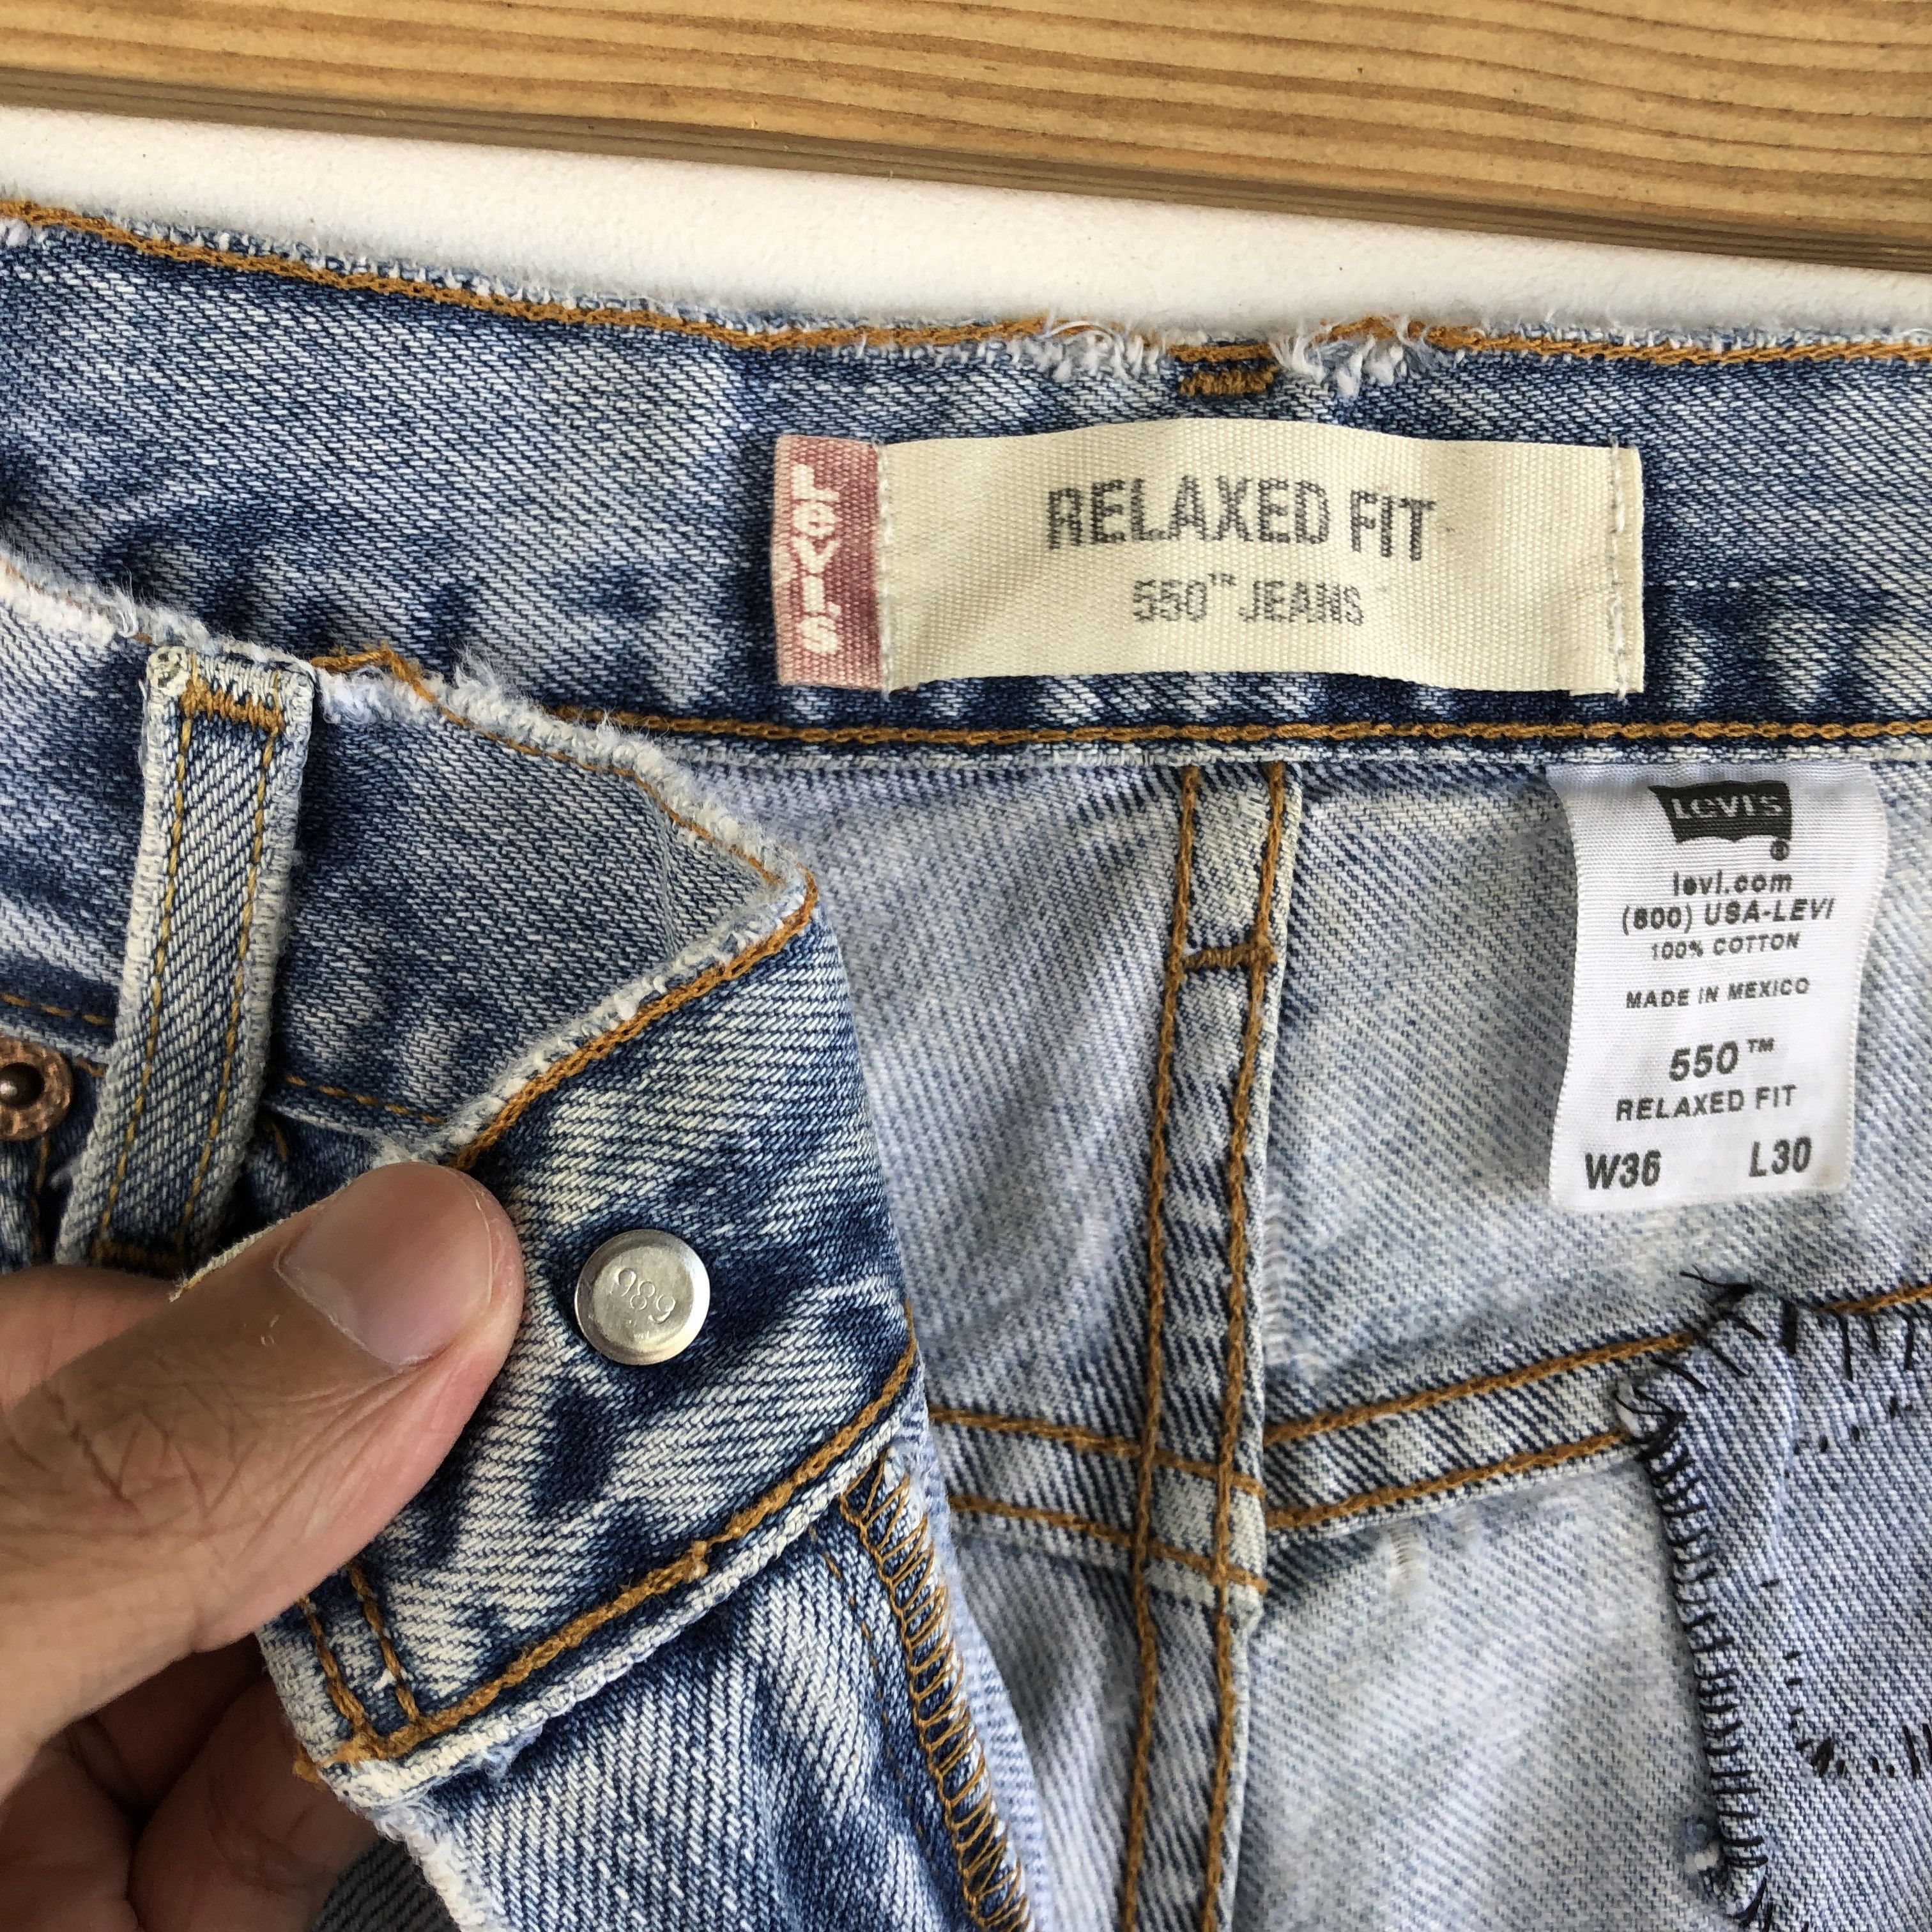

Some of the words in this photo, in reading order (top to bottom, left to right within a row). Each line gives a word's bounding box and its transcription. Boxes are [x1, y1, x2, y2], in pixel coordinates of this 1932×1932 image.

[1048, 475, 1330, 550] RELAXED
[1349, 489, 1437, 562] FIT
[1238, 579, 1364, 626] JEANS
[1673, 870, 1793, 896] levi.com
[1622, 903, 1694, 936] (800)
[1704, 898, 1836, 926] USA-LEVI
[1651, 939, 1704, 960] 100%
[1713, 931, 1801, 957] COTTON
[1625, 988, 1689, 1009] MADE
[1698, 985, 1719, 1004] IN
[1727, 977, 1810, 1001] MEXICO
[1616, 1088, 1745, 1123] RELAXED
[1755, 1084, 1798, 1110] FIT
[1584, 1149, 1662, 1190] W36
[1748, 1135, 1813, 1177] L30
